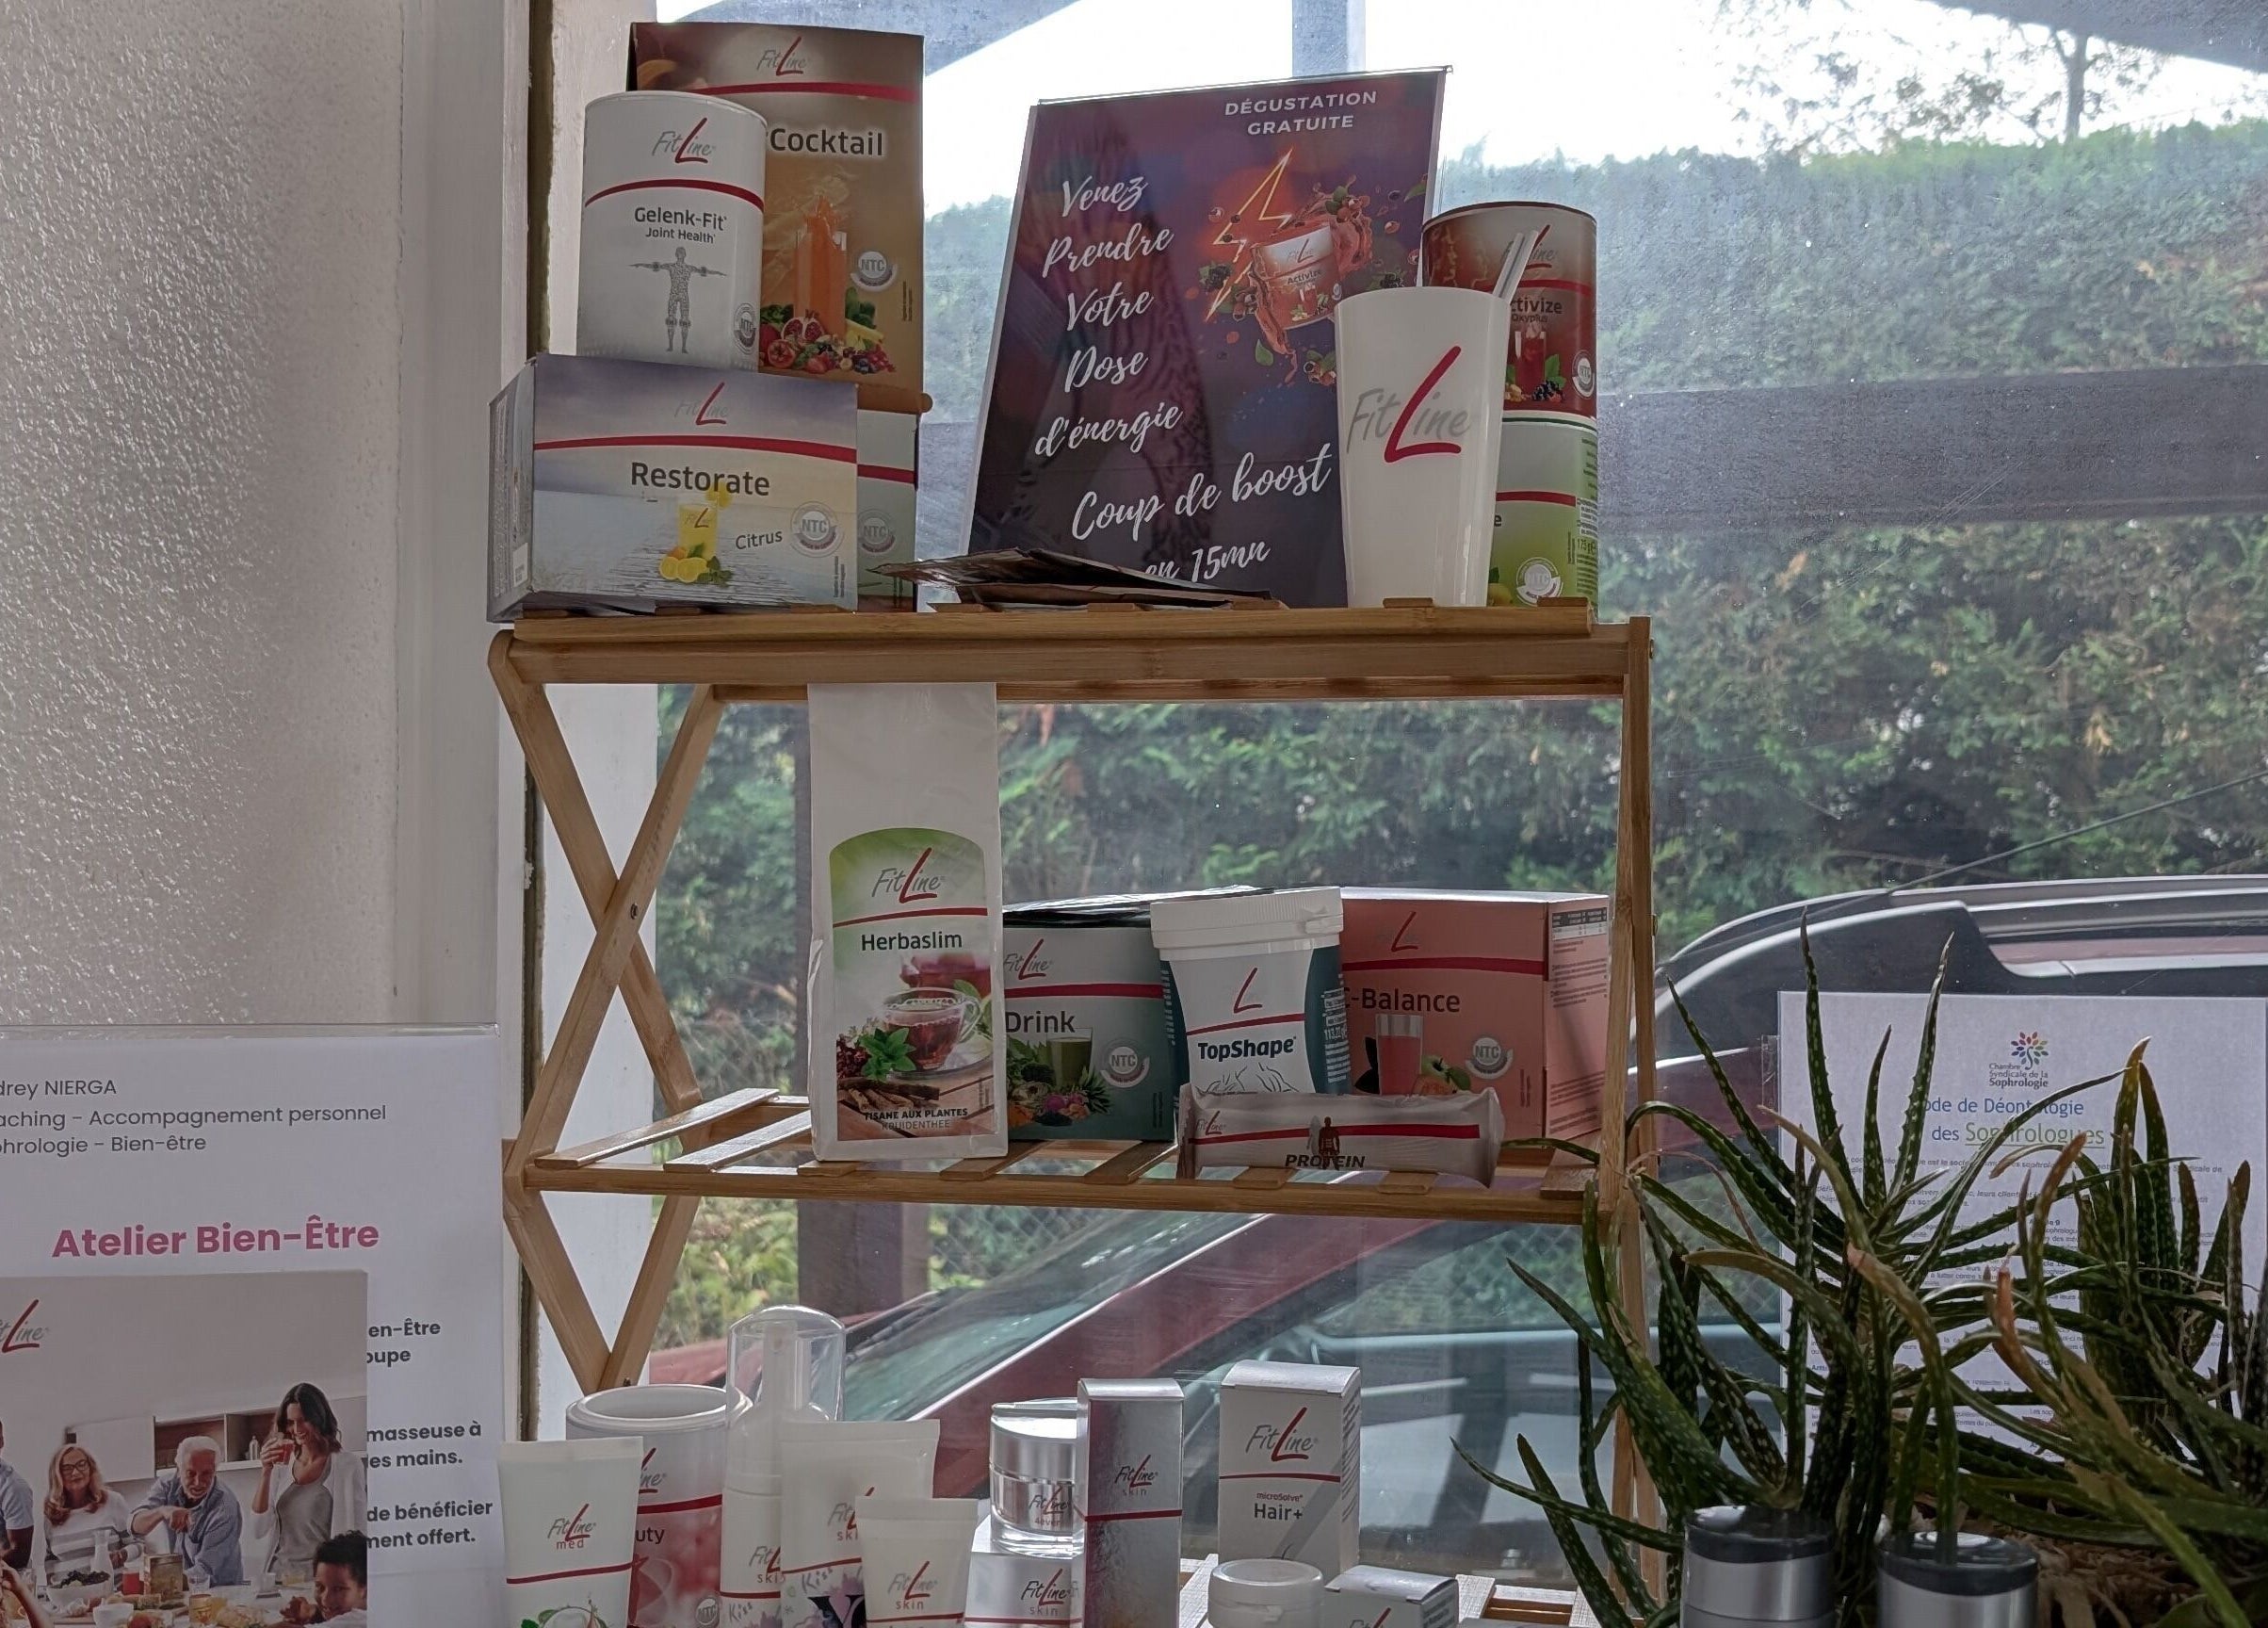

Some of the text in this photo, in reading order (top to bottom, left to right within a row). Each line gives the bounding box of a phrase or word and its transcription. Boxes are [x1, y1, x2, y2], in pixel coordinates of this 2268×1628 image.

[756, 36, 808, 75] FitLine
[1224, 91, 1377, 116] DÉGUSTATION
[1247, 115, 1354, 136] GRATUITE
[652, 118, 712, 163] FitLine
[766, 127, 883, 156] Cocktail
[1061, 175, 1149, 218] Venez
[645, 227, 714, 244] Joint Health
[1043, 222, 1174, 279] Prendre
[861, 258, 885, 272] NTC
[1066, 286, 1155, 332] Votre
[1511, 297, 1563, 315] ctivize
[1063, 346, 1149, 393] Dose
[1347, 345, 1470, 463] FitLine
[1035, 401, 1184, 459] d'énergie
[631, 462, 770, 497] Restorate
[1071, 443, 1334, 541] Coup de boost
[802, 517, 827, 534] NTC
[863, 524, 887, 538] NTC
[736, 530, 783, 550] Citrus
[1190, 540, 1273, 583] 15mn
[871, 847, 941, 904] FitLine
[861, 931, 963, 952] Herbaslim
[1003, 938, 1049, 980] FitLine
[1005, 1010, 1076, 1034] Drink
[1108, 1052, 1137, 1068] NTC
[1197, 1038, 1296, 1063] TopShape
[1473, 1044, 1500, 1059] NTC
[1989, 1070, 2027, 1079] Syndicale
[1989, 1077, 2049, 1090] Sophrologie
[45, 1080, 117, 1095] NIERGA
[89, 1106, 283, 1128] Accompagnement
[288, 1104, 387, 1126] personnel
[864, 1108, 968, 1121] TISANE AUX PLANTES
[1957, 1098, 1978, 1113] de
[1984, 1097, 2084, 1118] Déontlogie
[111, 1133, 206, 1152] Bien-être
[1932, 1126, 1960, 1141] des
[1284, 1154, 1367, 1169] PROTEIN
[52, 1214, 380, 1258] Atelier Bien-Être
[0, 1299, 44, 1354] tLine
[366, 1420, 481, 1441] masseuse à
[1245, 1407, 1314, 1461] FitLine
[397, 1449, 462, 1467] mains.
[1114, 1455, 1155, 1487] FitLine
[366, 1499, 493, 1522] de bénéficier
[1254, 1503, 1303, 1521] Hair+
[547, 1503, 592, 1541] FitLine
[416, 1528, 476, 1545] offert.
[556, 1539, 584, 1549] med
[635, 1526, 665, 1545] uty
[837, 1531, 858, 1540] ski
[757, 1573, 781, 1584] ski
[1021, 1569, 1066, 1605] FitLine
[897, 1601, 924, 1610] skin
[1029, 1606, 1058, 1616] skin
